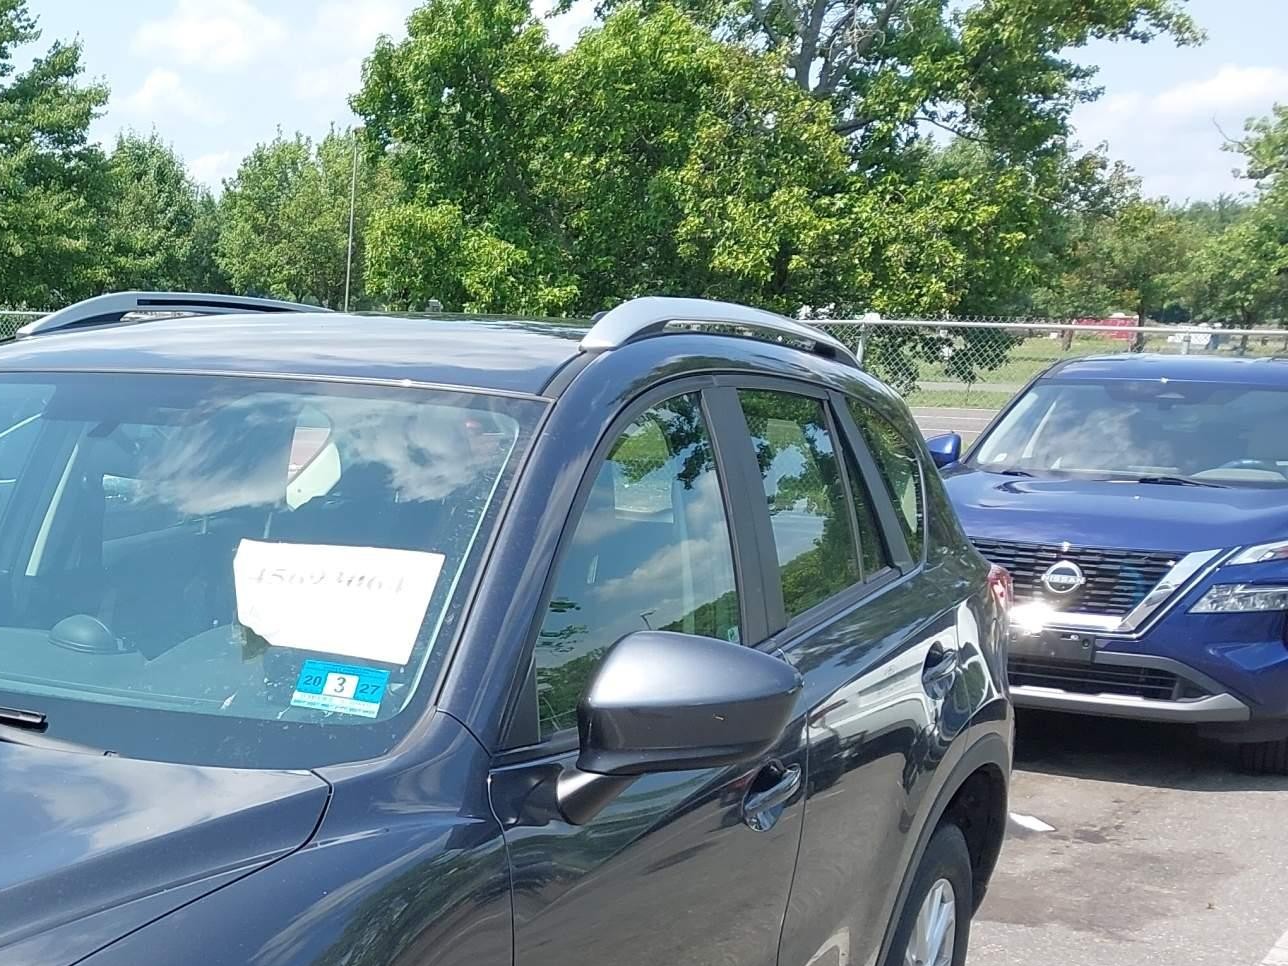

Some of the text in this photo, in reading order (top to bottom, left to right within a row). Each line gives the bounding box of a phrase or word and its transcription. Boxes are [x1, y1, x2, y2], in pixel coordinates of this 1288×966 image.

[303, 675, 380, 695] 20 3 27
